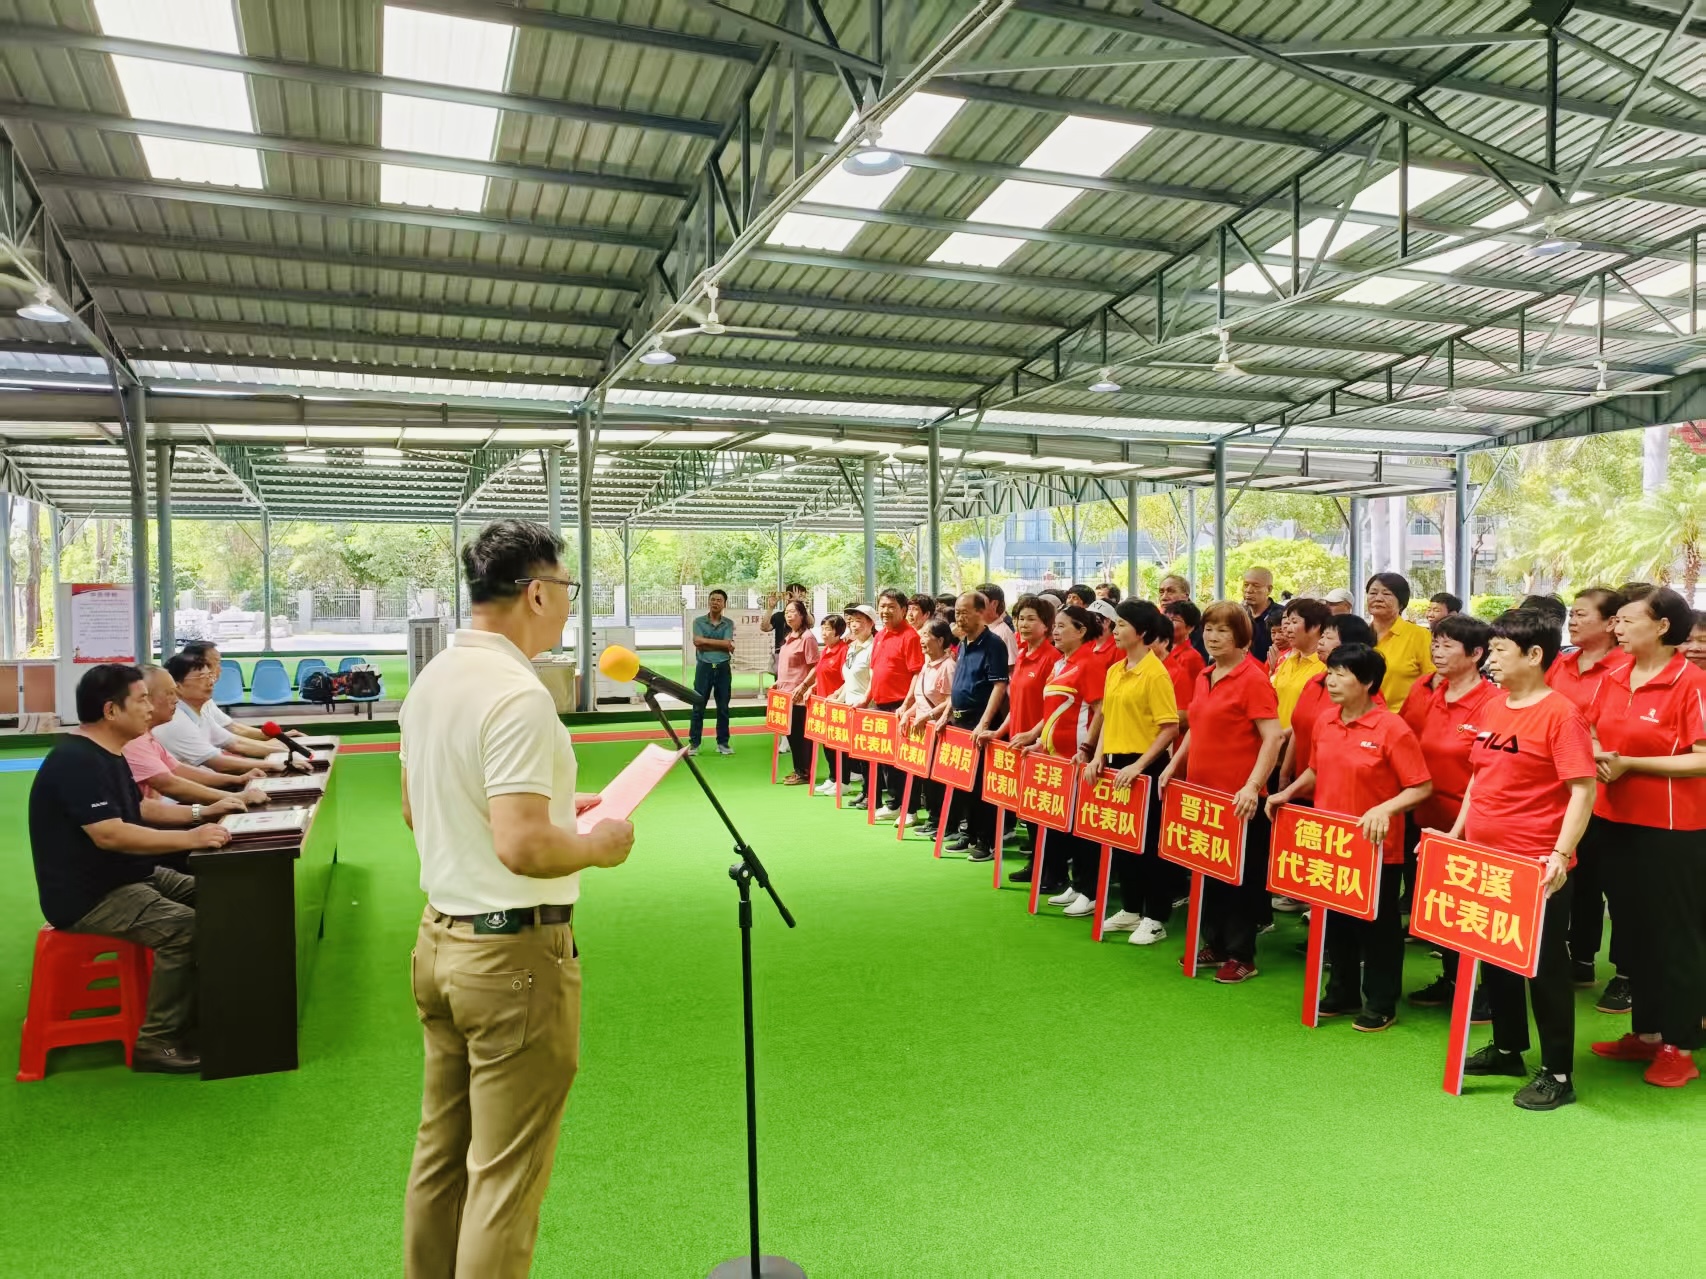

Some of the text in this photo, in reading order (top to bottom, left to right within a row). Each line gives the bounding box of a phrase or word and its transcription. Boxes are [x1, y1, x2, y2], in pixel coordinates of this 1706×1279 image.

[773, 695, 786, 710] 南安
[812, 702, 826, 718] 永春
[768, 710, 788, 726] 代表队
[861, 716, 888, 734] 台商
[827, 725, 850, 743] 代表队
[854, 734, 893, 755] 代表队
[1476, 731, 1519, 754] FILA
[899, 743, 926, 767] 代表队
[939, 741, 973, 773] 裁判员
[993, 748, 1016, 773] 惠安
[987, 771, 1018, 799] 代表队
[1033, 763, 1063, 789] 丰泽
[1023, 786, 1065, 818] 代表队
[1180, 793, 1225, 830] 晋江
[1081, 802, 1136, 838] 代表队
[1166, 822, 1232, 868] 代表队
[1295, 818, 1354, 858] 德化
[1277, 850, 1364, 900] 代表队
[1443, 854, 1514, 903] 安溪
[1424, 889, 1524, 952] 代表队
